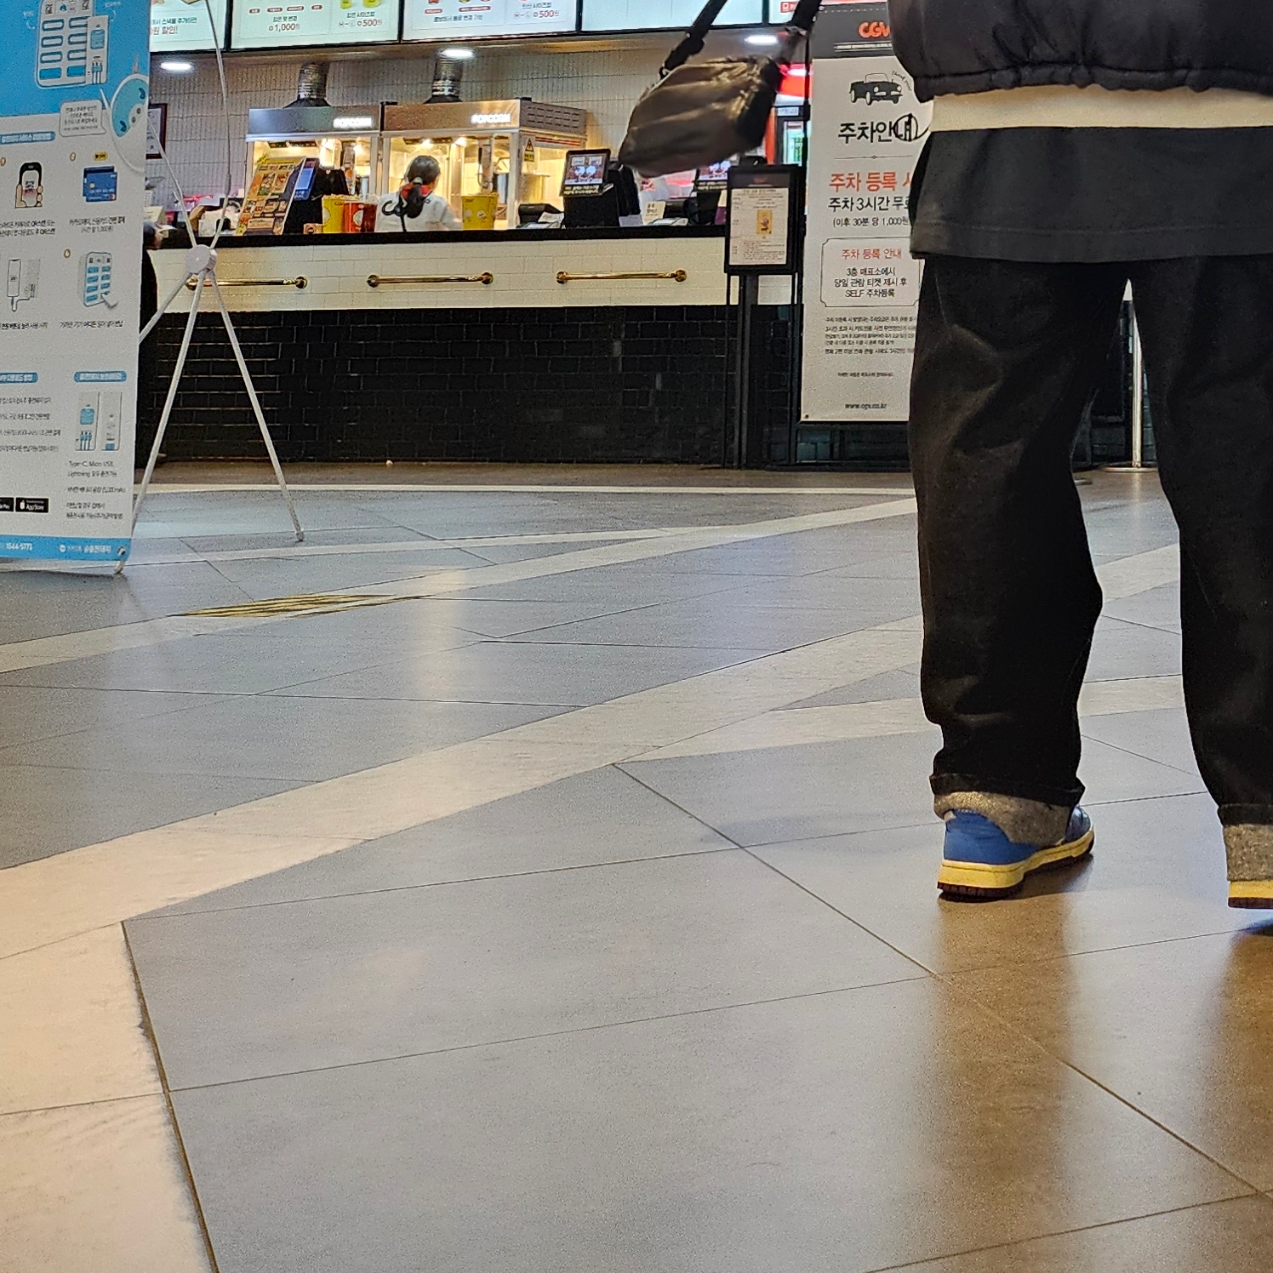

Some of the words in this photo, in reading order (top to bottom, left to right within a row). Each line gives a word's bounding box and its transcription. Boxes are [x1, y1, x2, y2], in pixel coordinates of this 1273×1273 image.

[829, 171, 861, 193] 주차
[866, 171, 897, 193] 등록
[828, 197, 854, 212] 주차
[856, 196, 891, 212] 3시간
[833, 217, 850, 227] (이후
[853, 217, 869, 226] 30분
[842, 249, 859, 259] 주차
[862, 249, 881, 259] 등록
[884, 248, 901, 259] 안내
[847, 268, 858, 276] 3층
[867, 278, 882, 287] 티켓
[883, 278, 898, 286] 제시
[900, 277, 907, 286] 후
[846, 289, 864, 298] SELF
[866, 288, 895, 298] 주차등록
